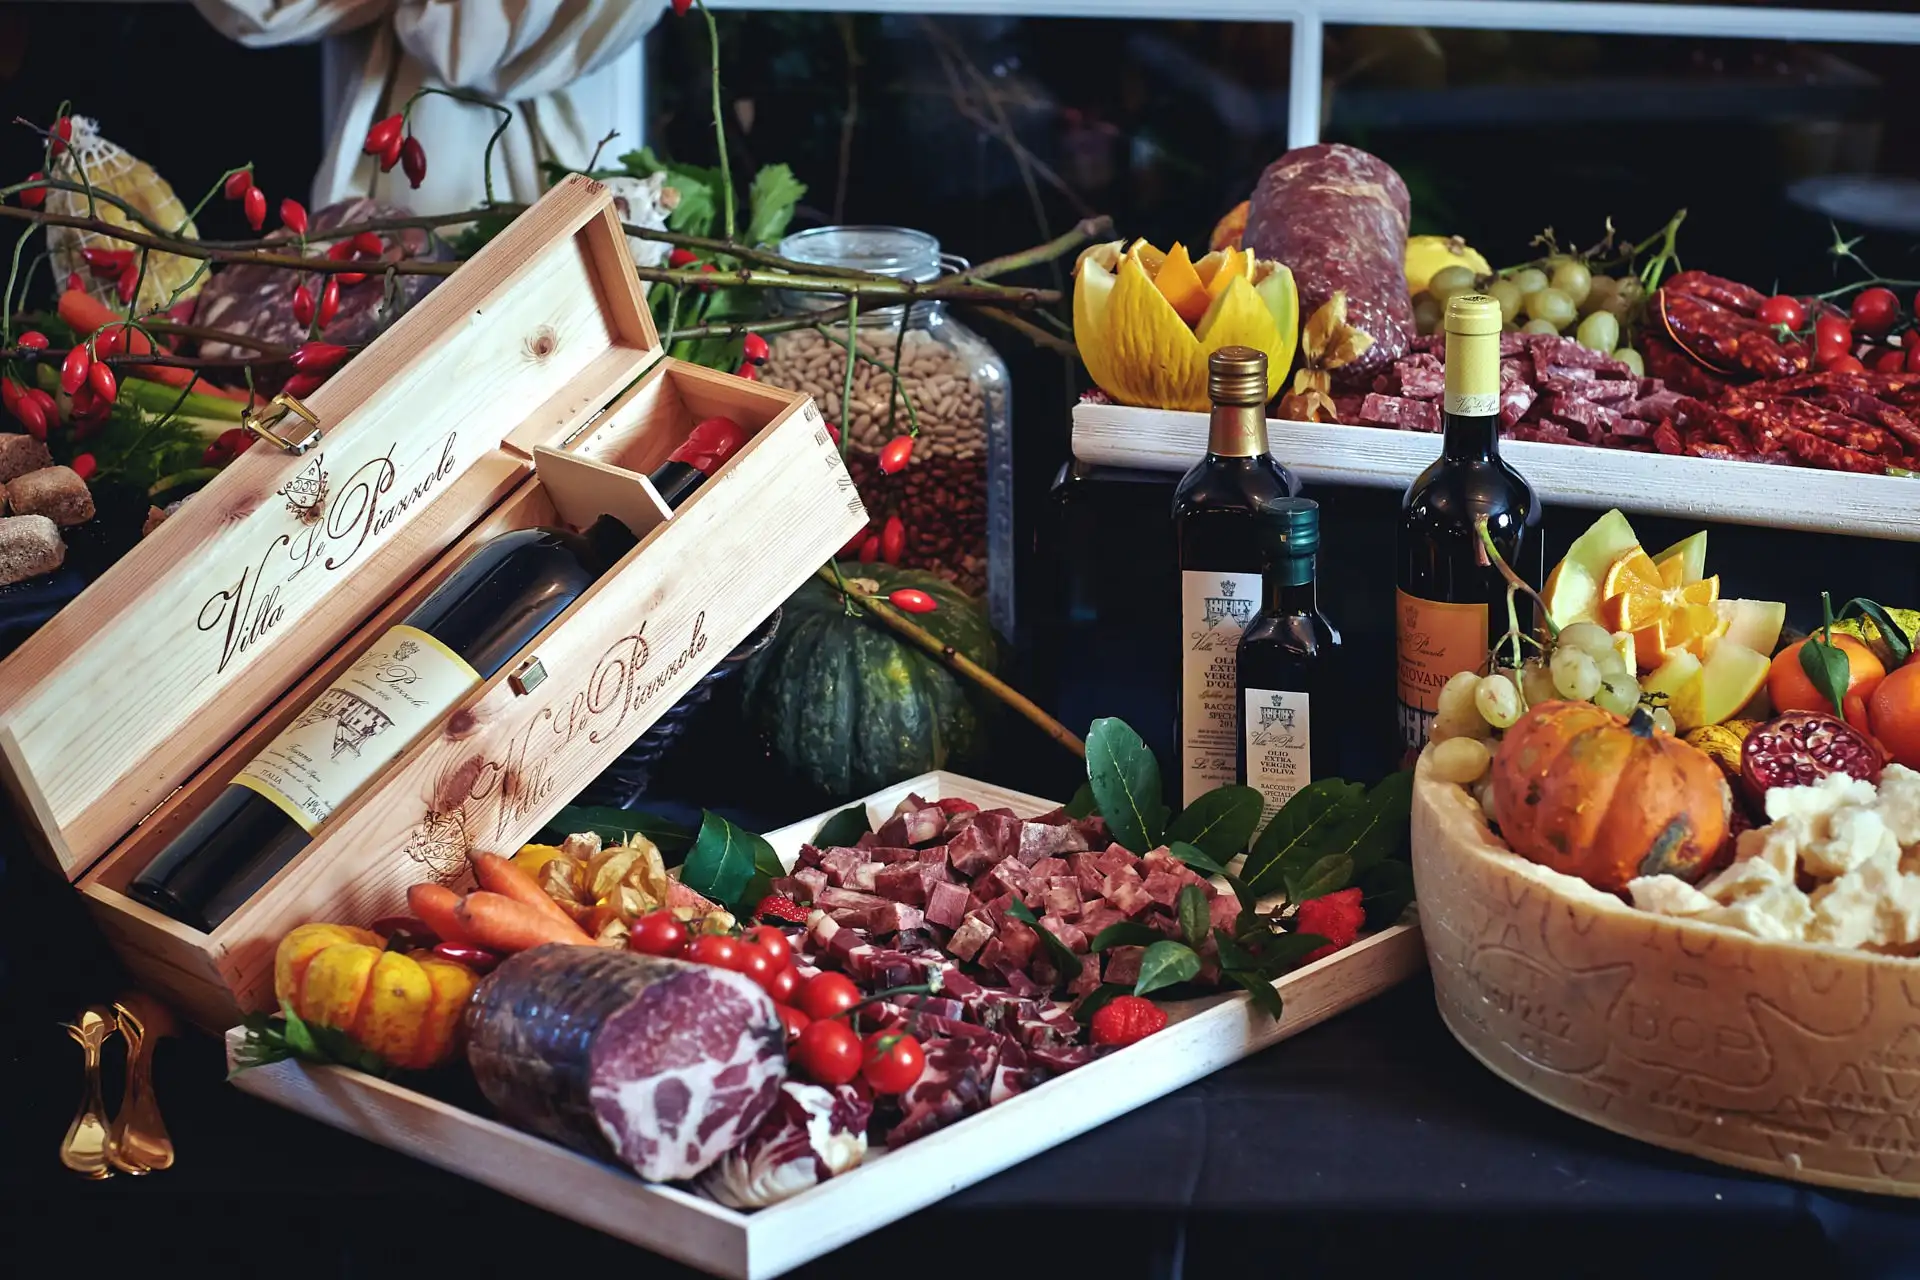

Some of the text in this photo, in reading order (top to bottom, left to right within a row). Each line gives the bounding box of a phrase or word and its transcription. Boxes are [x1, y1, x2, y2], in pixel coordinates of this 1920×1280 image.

[197, 431, 458, 674] Villa Le Piazzole
[1191, 631, 1219, 651] Villa
[1214, 656, 1237, 665] OLI
[1219, 720, 1237, 729] 201
[1264, 755, 1292, 763] EXTRA
[471, 707, 554, 842] Villa
[552, 691, 588, 752] Le
[1260, 761, 1297, 769] VERGINE
[1262, 767, 1295, 776] D'OLIVA
[260, 769, 283, 785] ITALIA
[1260, 783, 1296, 792] RACCOLTO
